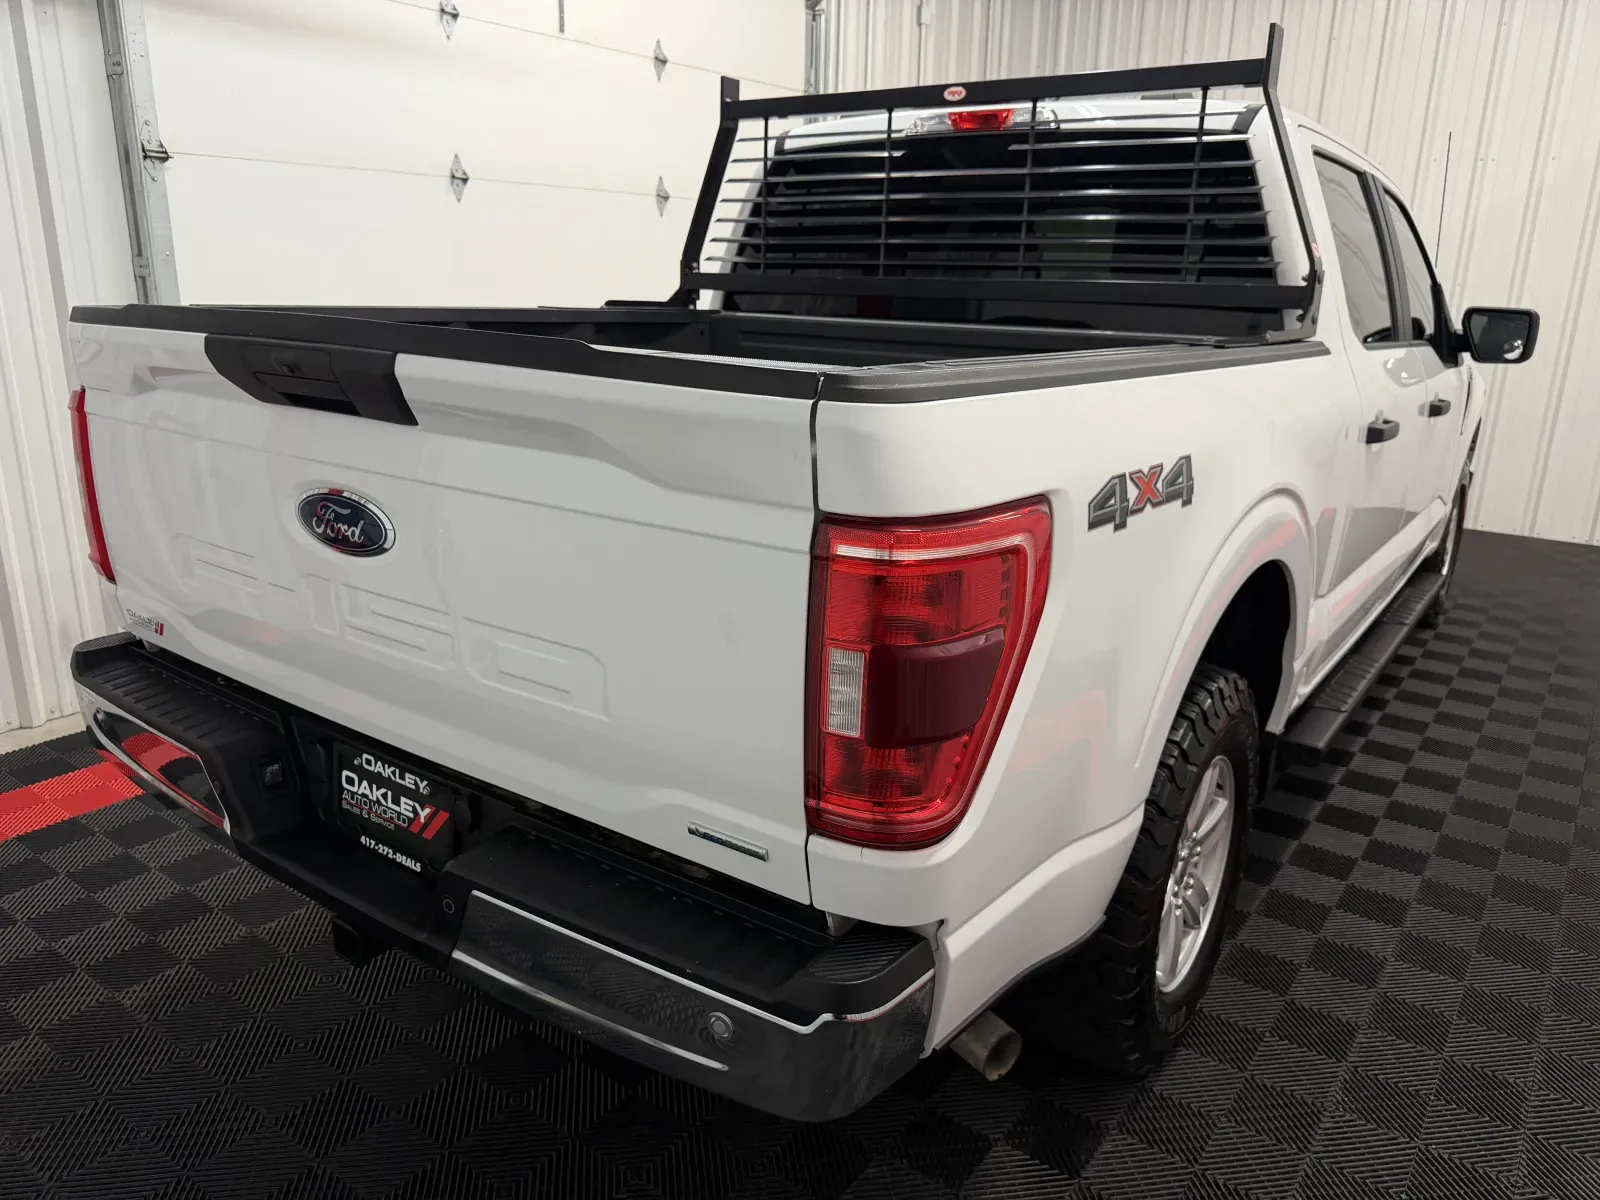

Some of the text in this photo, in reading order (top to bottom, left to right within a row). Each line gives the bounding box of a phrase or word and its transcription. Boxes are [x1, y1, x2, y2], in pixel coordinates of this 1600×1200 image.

[313, 501, 365, 543] Ford
[362, 753, 428, 793] OAKLEY
[341, 769, 431, 823] OAKLEY
[342, 790, 409, 827] AUTO WORLD
[362, 810, 369, 818] &
